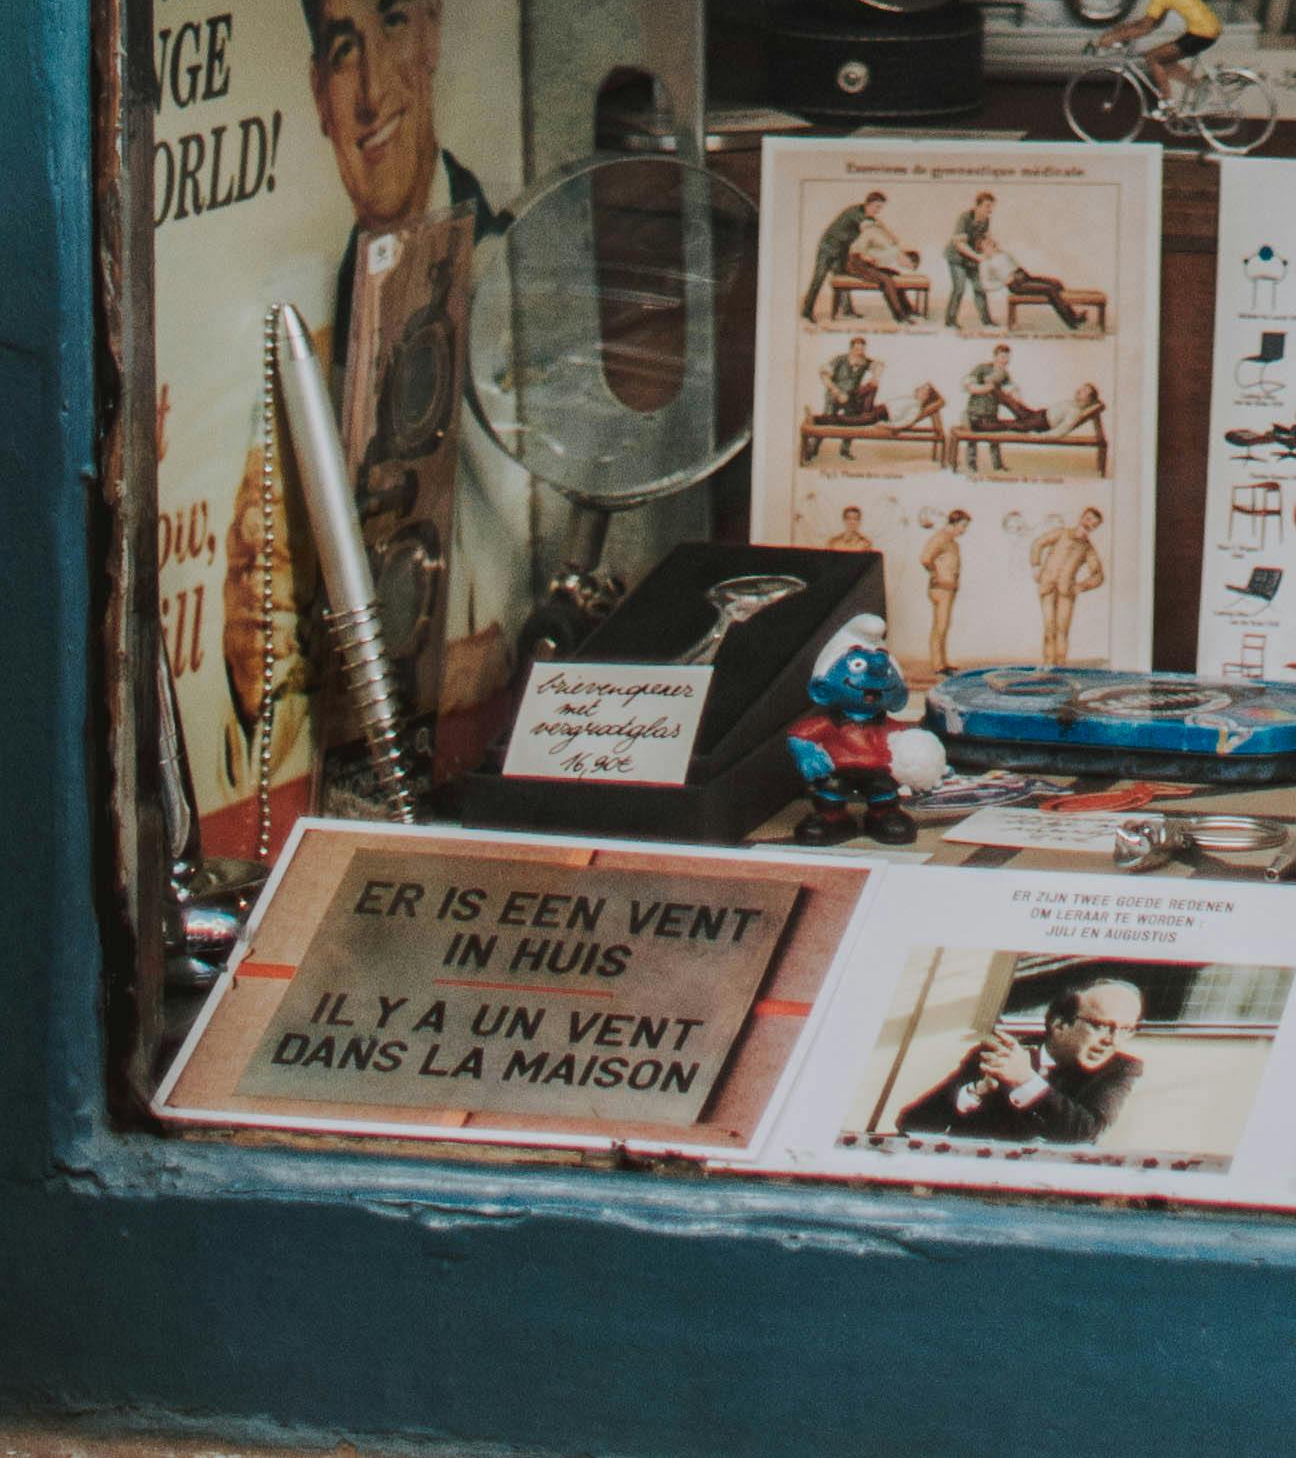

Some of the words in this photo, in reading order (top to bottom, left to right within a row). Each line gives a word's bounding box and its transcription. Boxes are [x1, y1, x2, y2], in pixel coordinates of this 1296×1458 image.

[555, 699, 601, 717] met
[354, 880, 425, 919] ER
[436, 886, 486, 922] IS
[497, 890, 606, 933] EEN
[627, 900, 763, 944] VENT
[1012, 890, 1032, 903] ER
[1036, 892, 1068, 904] ZIJN
[1073, 894, 1112, 906] TWEE
[1116, 896, 1163, 909] GOEDE
[1168, 898, 1235, 913] REDENEN
[1030, 907, 1052, 919] OM
[1056, 909, 1108, 923] LERAAR
[1114, 913, 1129, 924] TE
[1046, 925, 1077, 937] JULI
[1081, 927, 1100, 939] EN
[1104, 929, 1178, 943] AUGUSTUS
[444, 932, 498, 968] IN
[508, 938, 633, 977] HUIS
[310, 992, 355, 1027] IL
[376, 996, 407, 1028] Y
[413, 1000, 447, 1034] A
[471, 1004, 545, 1041] UN
[566, 1011, 704, 1051] VENT
[271, 1031, 408, 1073] DANS
[418, 1043, 485, 1080] LA
[501, 1050, 701, 1094] MAISON
